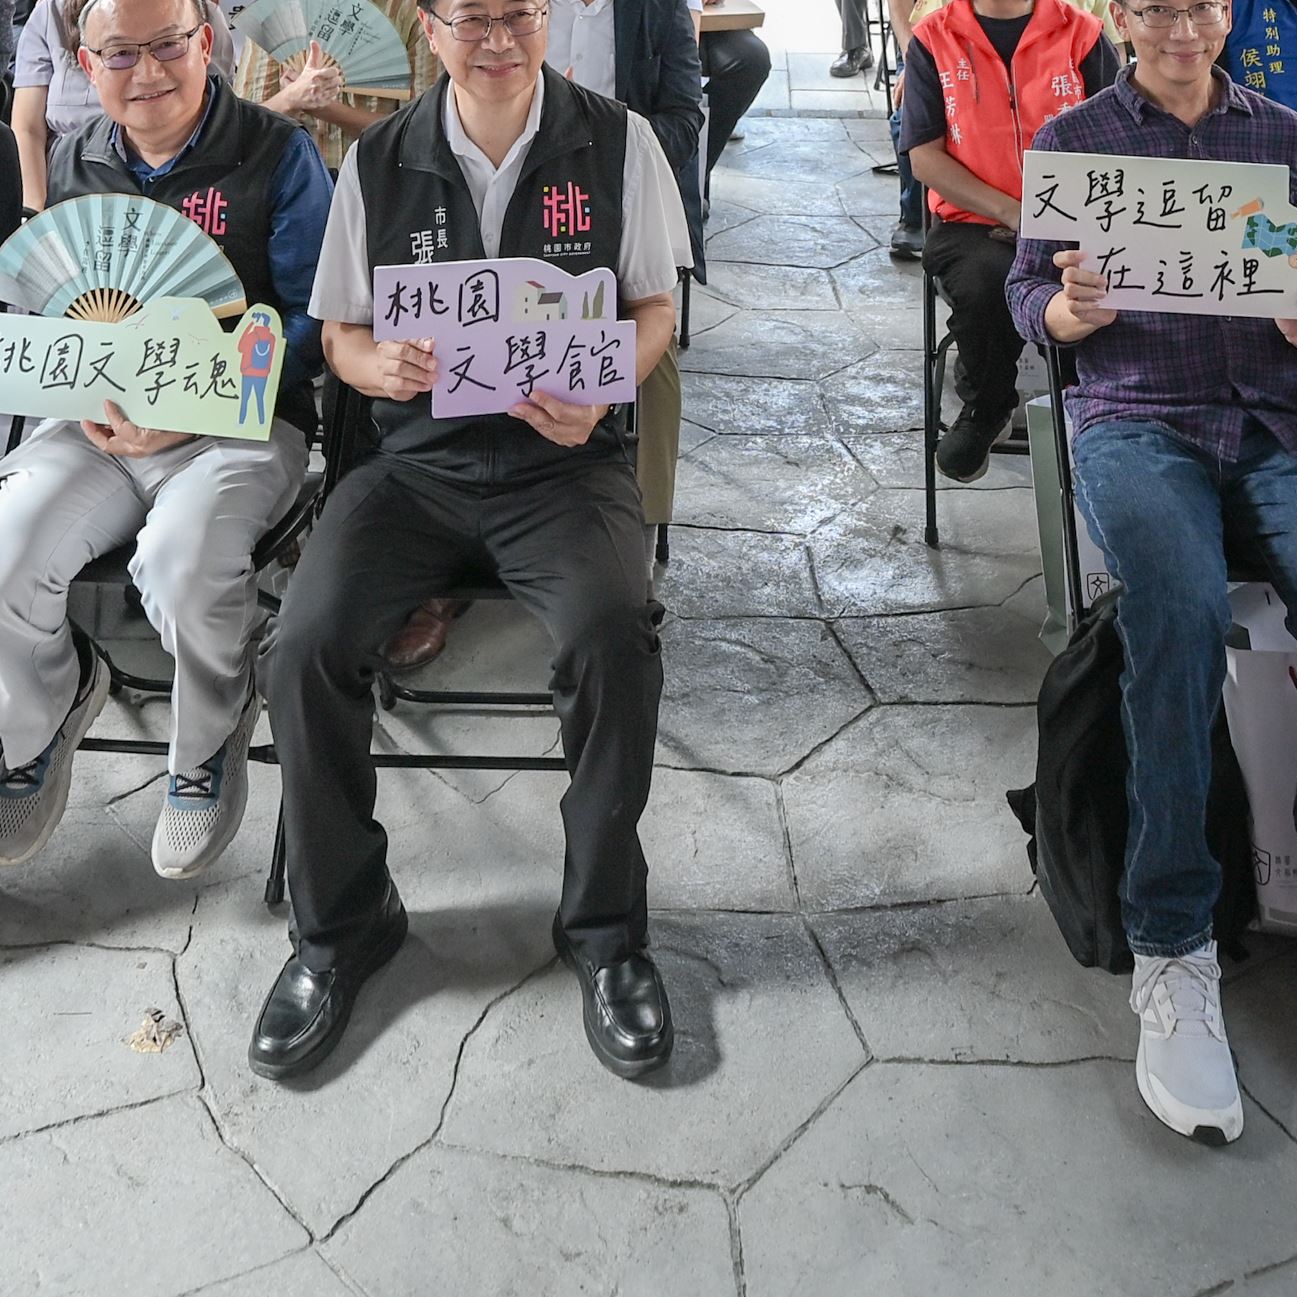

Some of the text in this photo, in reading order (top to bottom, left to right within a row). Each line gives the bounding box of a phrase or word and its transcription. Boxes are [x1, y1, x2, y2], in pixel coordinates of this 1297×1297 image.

[339, 2, 365, 36] 文學
[1263, 7, 1285, 75] 特別助理
[956, 57, 971, 81] 主任
[1240, 48, 1267, 92] 侯翊
[1033, 168, 1234, 233] 文學逗留
[118, 207, 144, 257] 文學
[410, 230, 434, 263] 張
[434, 206, 448, 249] 市長
[543, 242, 592, 253] 桃園市政府
[1095, 247, 1285, 301] 在這裡
[384, 269, 500, 327] 桃園
[447, 330, 626, 398] 文學館
